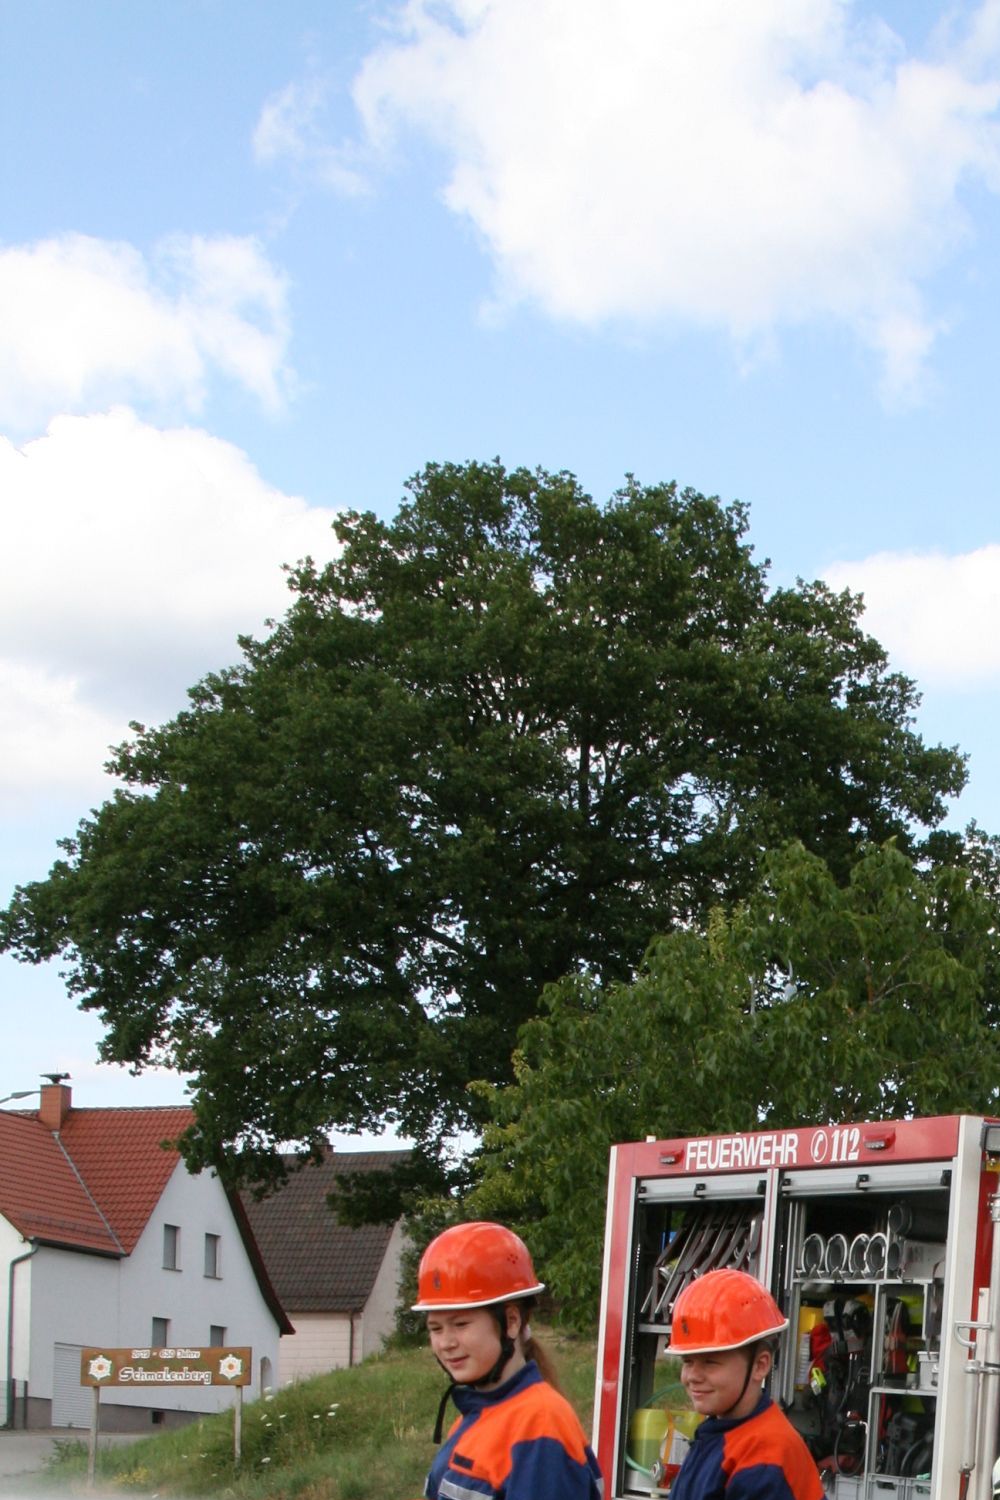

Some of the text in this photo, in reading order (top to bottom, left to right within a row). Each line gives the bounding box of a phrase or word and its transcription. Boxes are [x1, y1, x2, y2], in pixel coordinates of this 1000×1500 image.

[685, 1127, 860, 1171] FEUERWEHR 112
[119, 1366, 212, 1385] Schmalenberg
